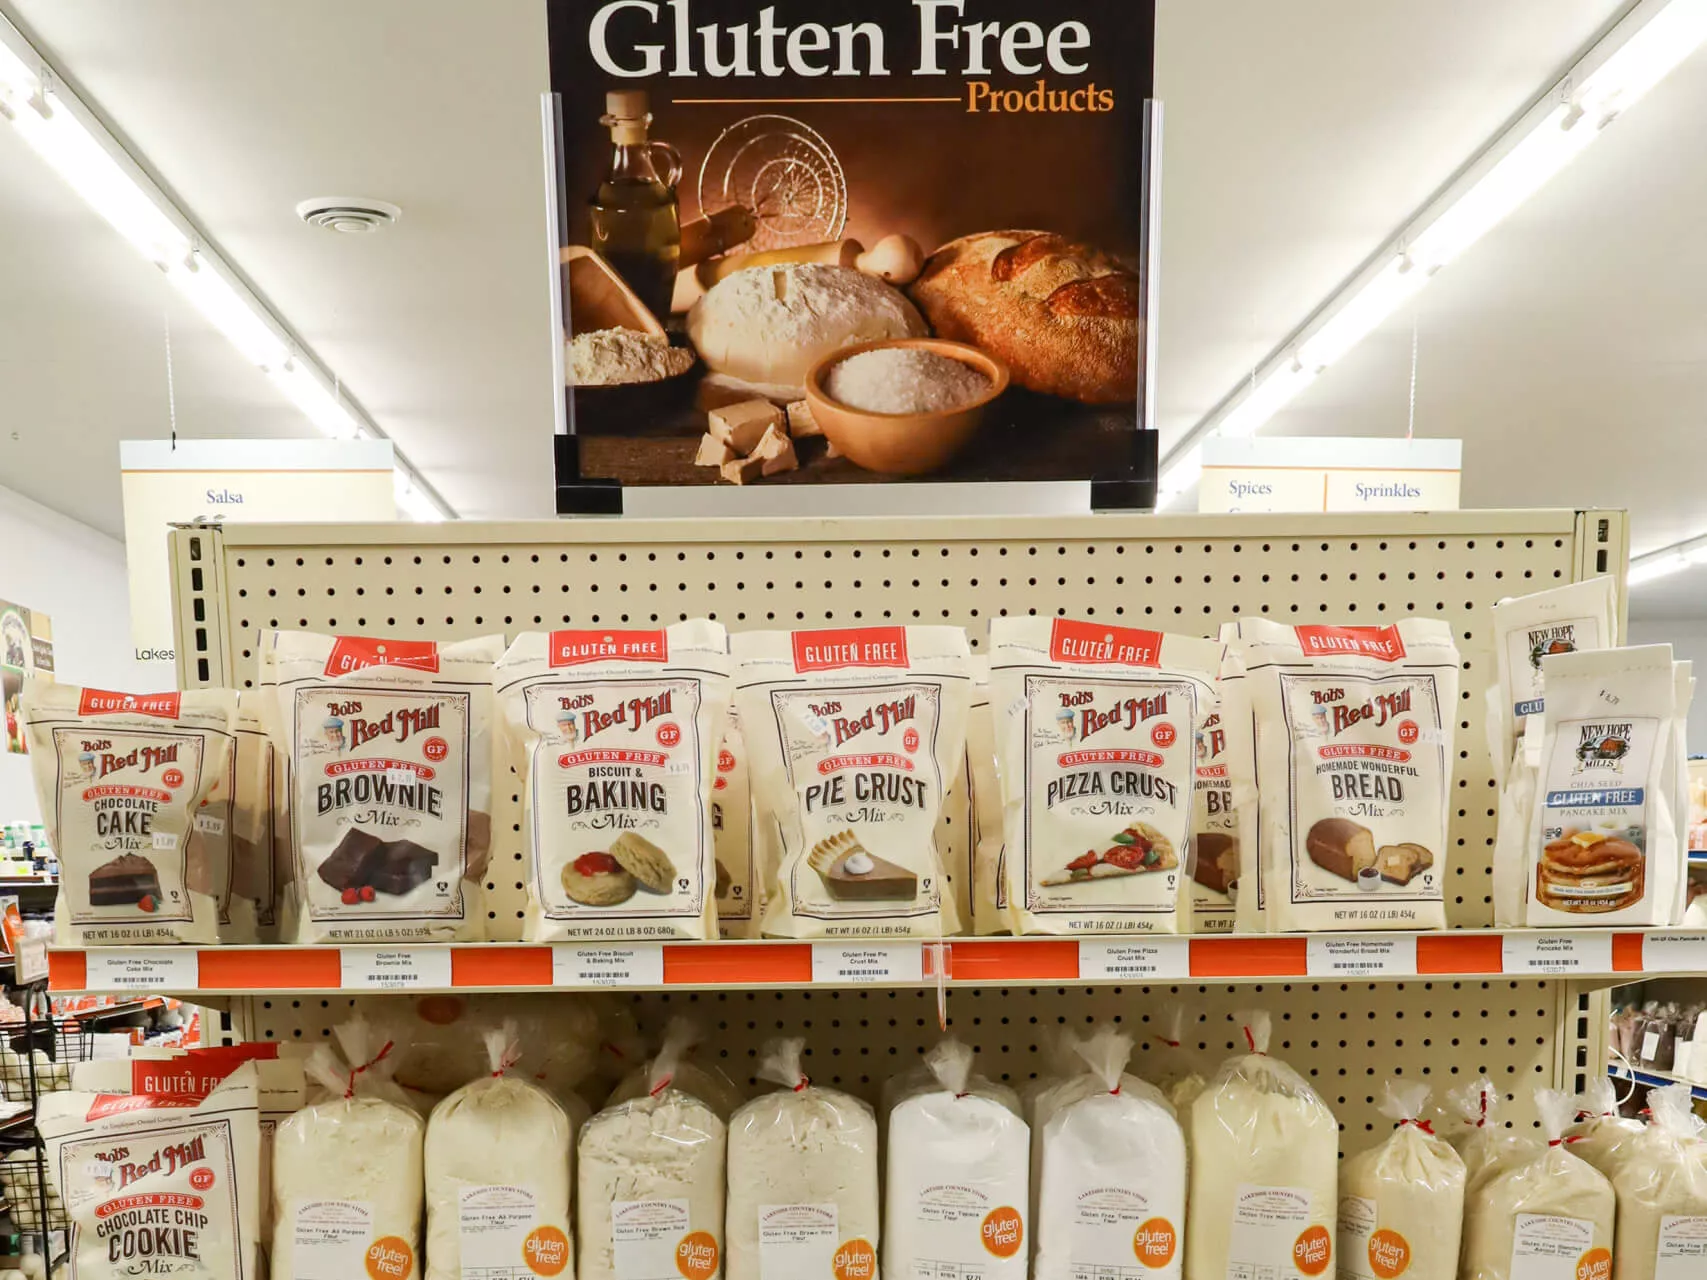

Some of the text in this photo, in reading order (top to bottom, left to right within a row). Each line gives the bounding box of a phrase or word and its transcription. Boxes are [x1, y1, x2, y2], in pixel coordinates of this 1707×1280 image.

[588, 0, 1091, 78] Gluten Free
[965, 81, 1114, 114] Products
[206, 489, 244, 504] Salsa
[1229, 479, 1273, 498] Spices
[1355, 482, 1421, 501] Sprinkles
[1528, 624, 1576, 646] NEW HOPE
[135, 648, 175, 660] Lakes
[561, 641, 658, 658] GLUTEN FREE
[805, 641, 898, 663] GLUTEN FREE
[1061, 638, 1113, 660] GLUTEN
[1310, 635, 1394, 655] GLUTEN FREE
[90, 696, 173, 712] GLUTEN FREE
[558, 694, 595, 711] Bob's
[1059, 691, 1094, 708] Bob's
[1311, 688, 1345, 704] Bob's
[326, 700, 363, 717] Bob's
[582, 689, 673, 742] Red Mill
[1080, 691, 1169, 742] Red Mill
[1332, 688, 1413, 736] Red Mill
[350, 702, 441, 751] Red Mill
[833, 694, 916, 747] Red Mill
[658, 729, 678, 740] GF
[1154, 729, 1173, 740] GF
[1399, 727, 1416, 738] GF
[1579, 723, 1633, 745] NEW HOPE
[81, 738, 113, 753] Bob's
[426, 744, 445, 754] GF
[99, 742, 181, 779] Red Mill
[566, 751, 661, 765] GLUTEN FREE
[1065, 751, 1155, 765] GLUTEN FREE
[1584, 758, 1615, 769] MILLS
[588, 767, 643, 778] BISCUIT &
[1316, 759, 1419, 777] HOMEMADE WONDERFUL
[806, 772, 928, 812] PIE CRUST
[1047, 770, 1178, 809] PIZZA CRUST
[1332, 773, 1404, 802] BREAD
[1570, 779, 1623, 789] CHIA SEED
[317, 773, 444, 820] BROWNIE
[566, 780, 667, 816] BAKING
[1553, 790, 1636, 805] GLUTEN FREE
[94, 799, 159, 813] CHOCOLATE
[846, 807, 887, 823] Mix
[1089, 799, 1135, 816] Mix
[1349, 802, 1385, 818] Mix
[1559, 806, 1628, 817] PANCAKE MIX
[97, 811, 153, 837] CAKE
[354, 809, 400, 826] Mix
[592, 812, 638, 830] Mix
[104, 836, 143, 851] Mix
[567, 927, 581, 937] NET
[582, 927, 593, 937] WT
[595, 927, 604, 937] 24
[606, 927, 615, 937] OZ
[617, 927, 624, 937] (1
[626, 927, 635, 937] LB
[658, 926, 676, 937] 680g
[144, 1075, 196, 1094] GLUTEN
[118, 1136, 206, 1191] Red Mill
[193, 1174, 211, 1184] GF
[103, 1195, 194, 1214] GLUTEN FREE
[97, 1209, 208, 1238] CHOCOLATE CHIP
[984, 1217, 1019, 1237] gluten
[108, 1226, 201, 1263] COOKIE
[527, 1237, 564, 1256] gluten
[127, 1258, 174, 1275] Mix
